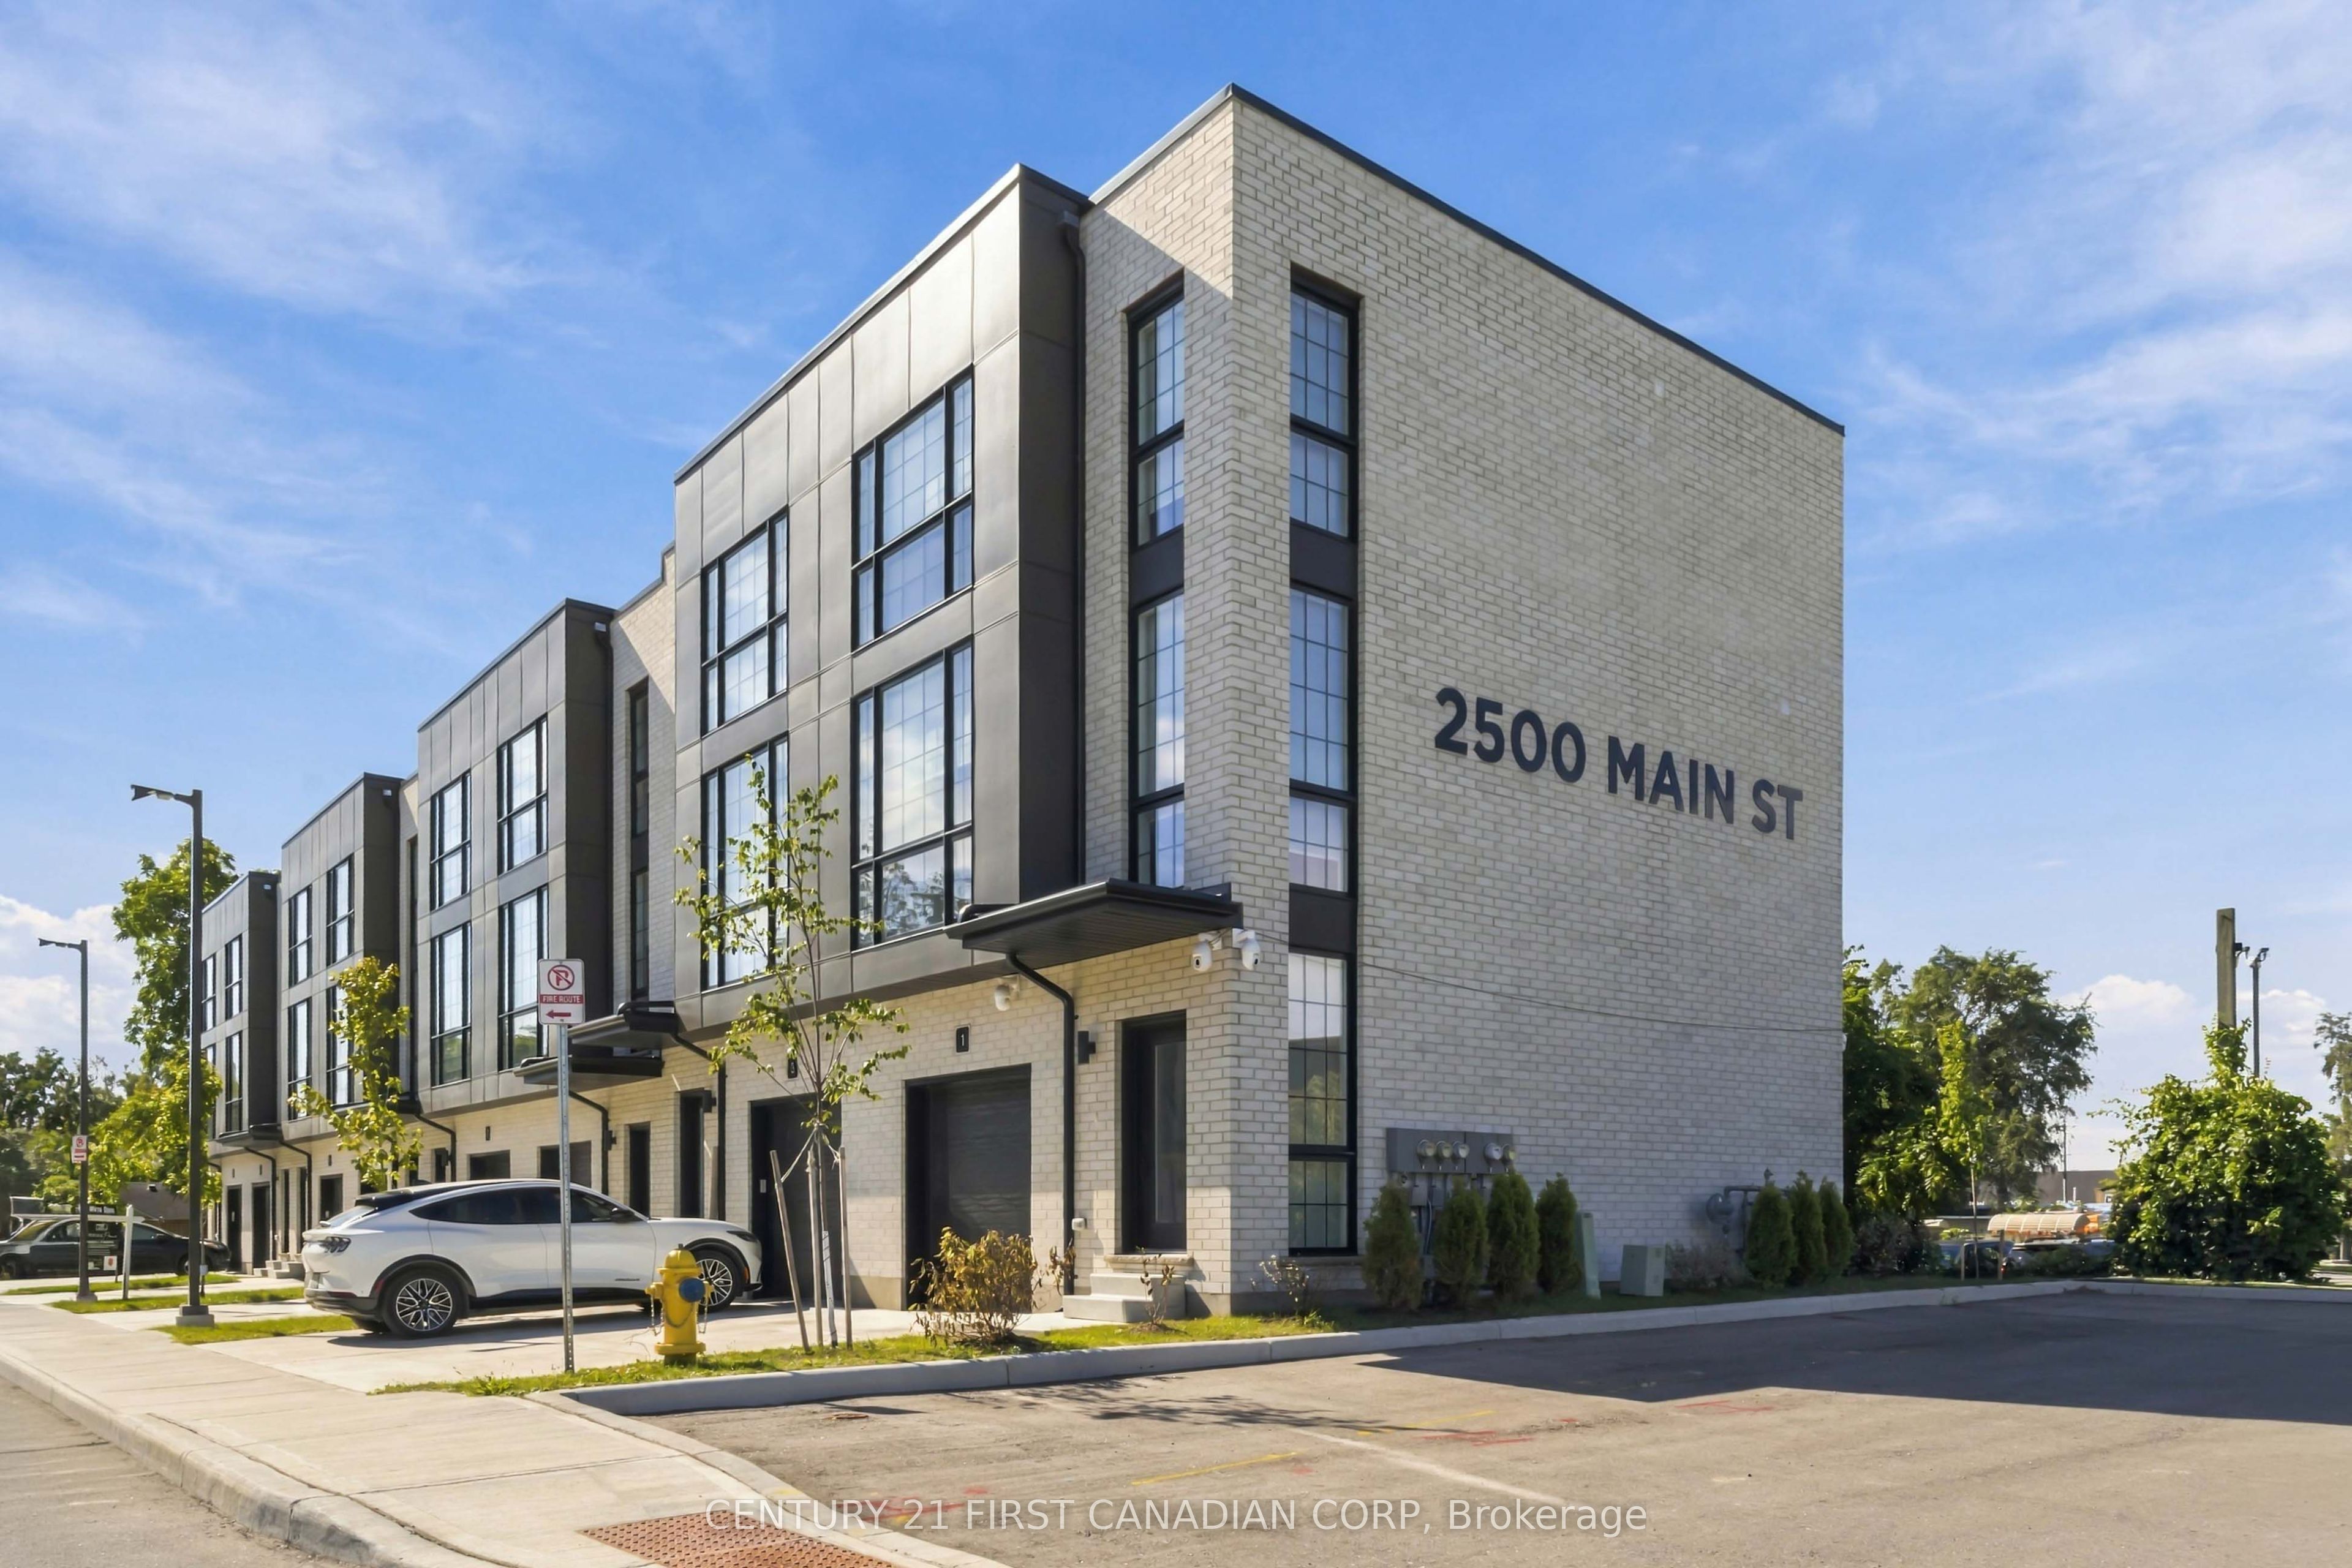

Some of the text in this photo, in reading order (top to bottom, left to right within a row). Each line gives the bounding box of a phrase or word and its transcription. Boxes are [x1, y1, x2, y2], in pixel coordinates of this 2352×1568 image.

[1434, 687, 1804, 840] 2500 MAIN ST
[960, 1033, 965, 1047] 1
